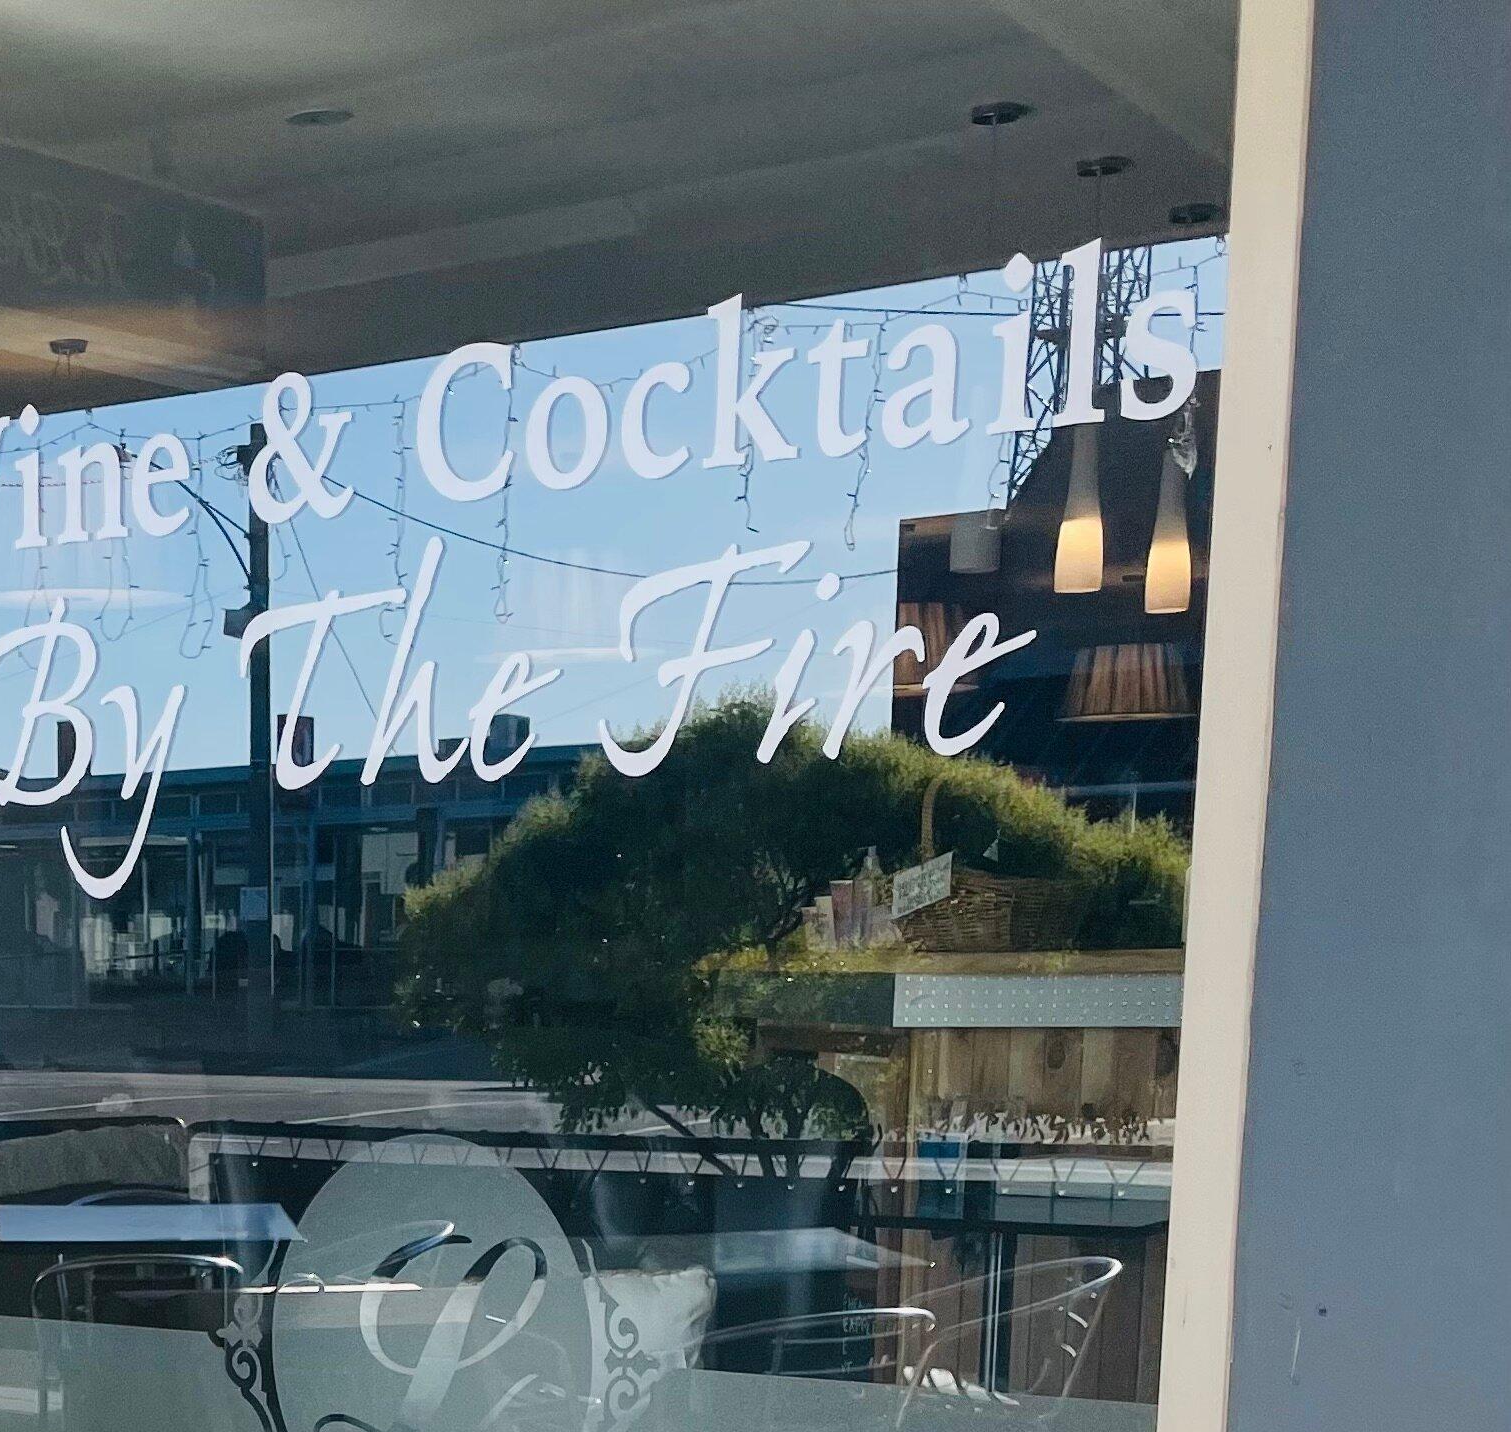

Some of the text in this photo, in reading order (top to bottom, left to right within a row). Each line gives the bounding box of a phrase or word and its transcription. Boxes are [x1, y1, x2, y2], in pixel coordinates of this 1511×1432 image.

[249, 371, 356, 525] &
[417, 237, 1199, 502] Cocktails
[239, 536, 562, 791] The
[598, 540, 1038, 778] Fire
